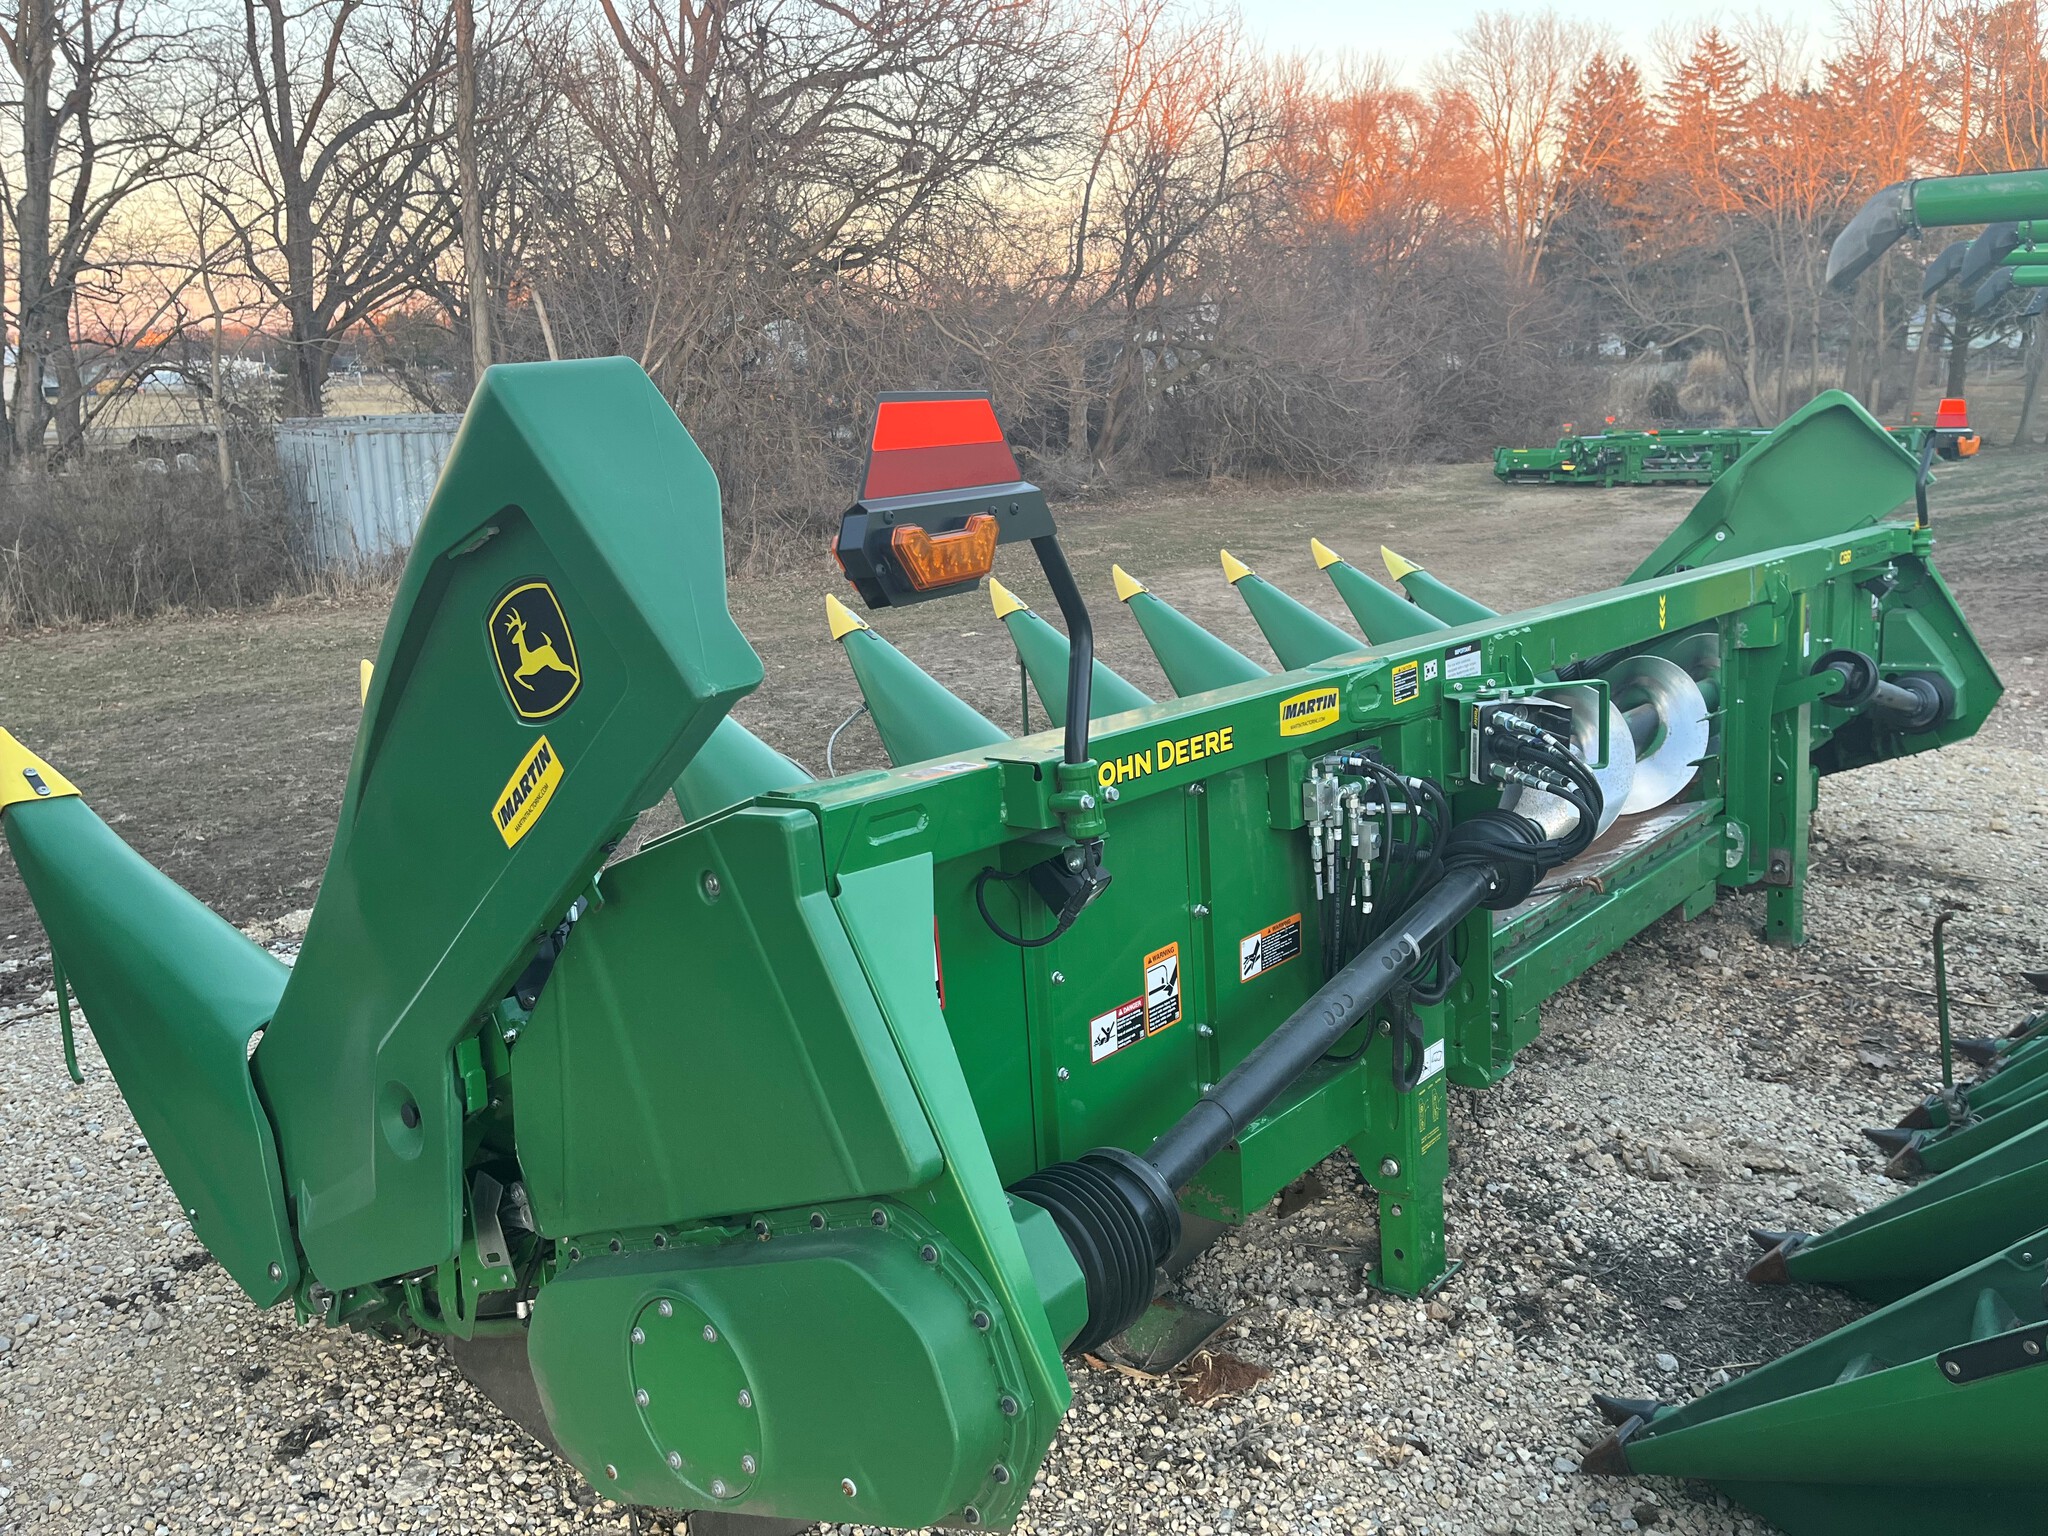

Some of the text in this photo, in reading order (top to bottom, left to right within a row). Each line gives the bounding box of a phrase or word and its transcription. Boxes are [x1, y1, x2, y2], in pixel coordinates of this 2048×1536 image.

[1282, 693, 1337, 720] MARTIN
[1098, 726, 1234, 787] OHN DEERE
[498, 742, 552, 831] MARTIN
[1152, 946, 1175, 962] WARNING
[1123, 1000, 1142, 1014] DANGER
